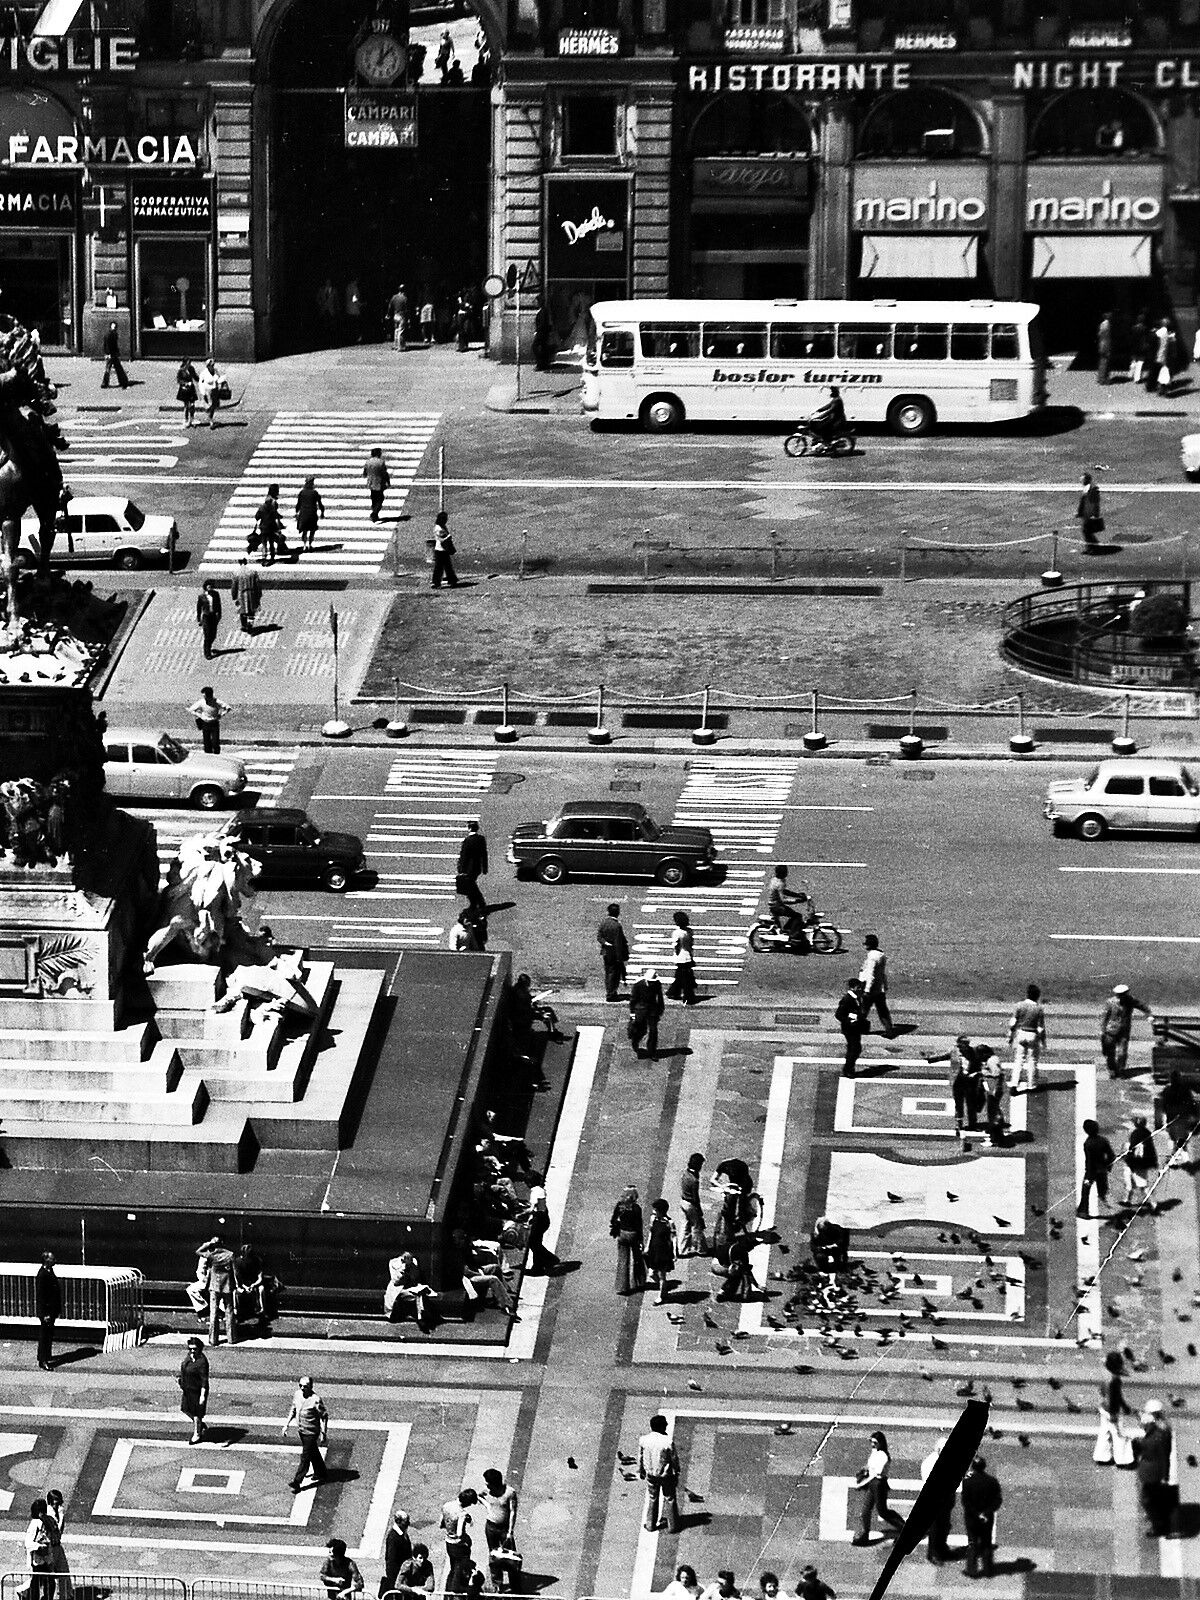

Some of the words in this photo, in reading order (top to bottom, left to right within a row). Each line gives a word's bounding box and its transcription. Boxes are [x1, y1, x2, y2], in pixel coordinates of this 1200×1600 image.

[559, 36, 619, 54] HERMES
[689, 63, 910, 91] RISTORANTE
[1013, 61, 1124, 88] NIGHT
[347, 106, 414, 120] CAMPARI
[8, 136, 196, 163] FARMACIA
[133, 196, 209, 206] COOPERATIVA
[133, 206, 209, 217] FARMACEUTICA
[854, 179, 987, 222] marino
[1027, 179, 1161, 222] marino
[712, 369, 795, 384] bosfor
[803, 369, 883, 384] turizm
